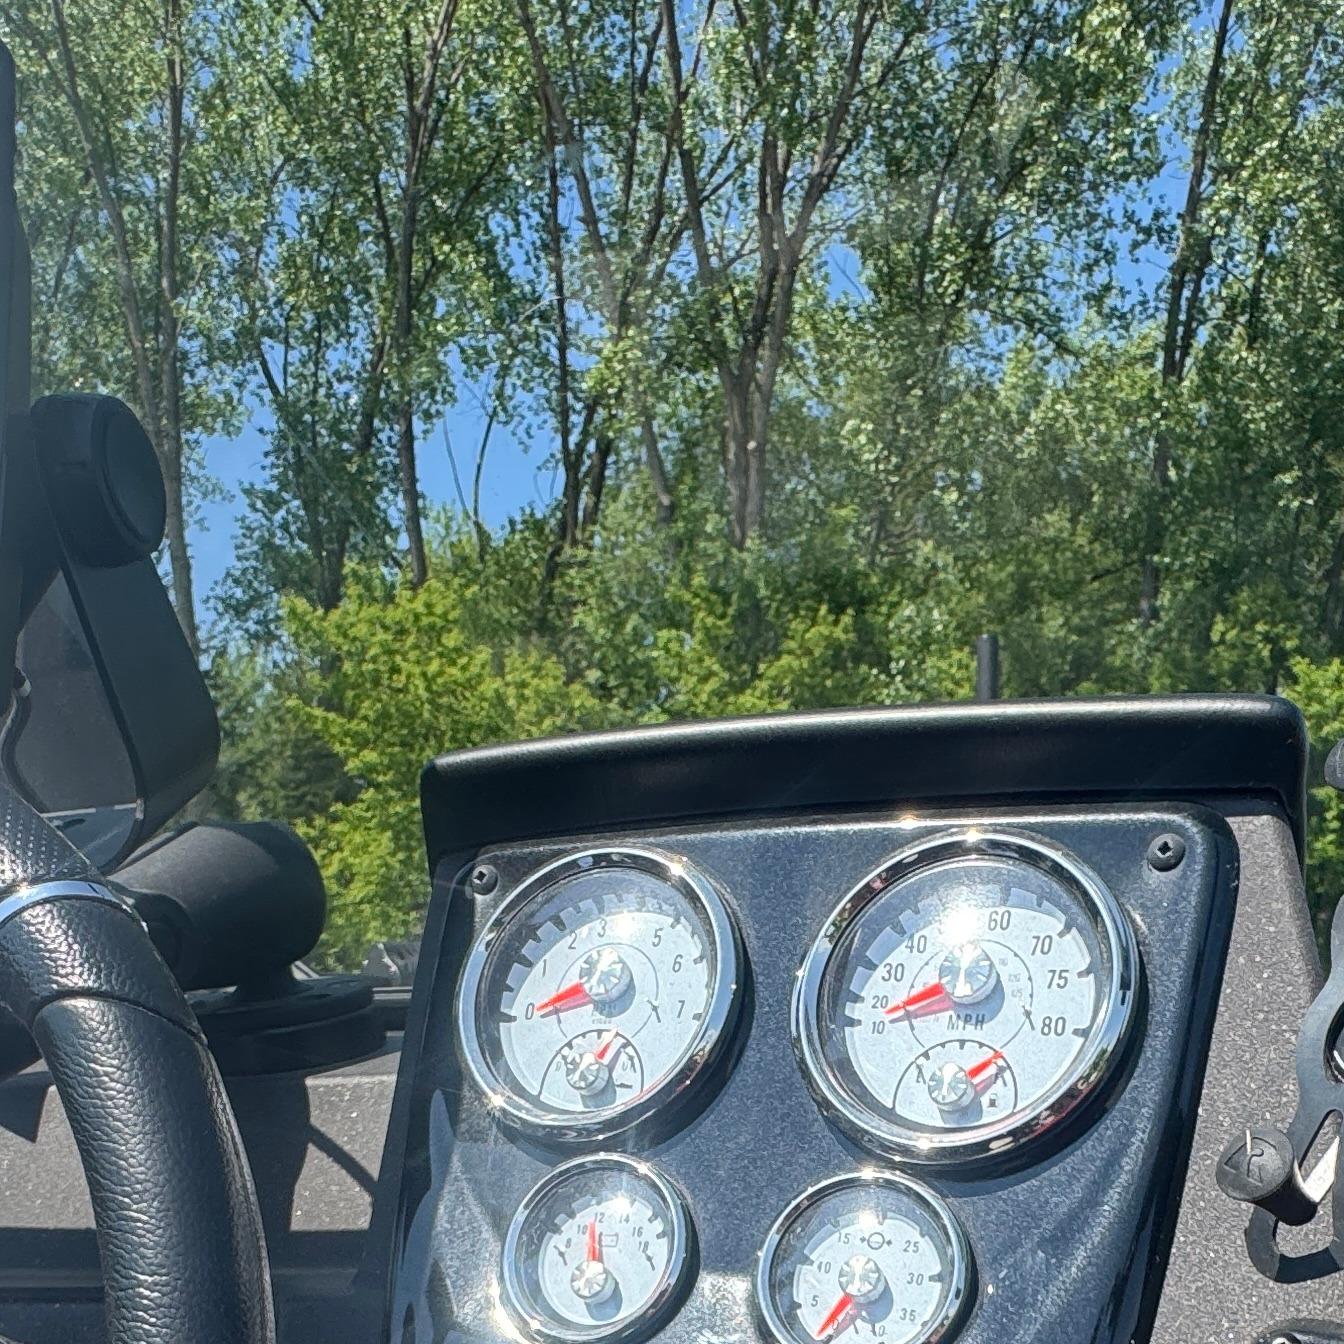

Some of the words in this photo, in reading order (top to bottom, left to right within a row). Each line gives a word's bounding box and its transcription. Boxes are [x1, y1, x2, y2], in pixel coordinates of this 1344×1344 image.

[597, 918, 606, 938] 3
[987, 910, 1012, 931] 60
[567, 932, 578, 950] 2
[652, 928, 663, 947] 5
[905, 934, 928, 954] 40
[1030, 935, 1053, 956] 70
[541, 959, 547, 977] 1
[672, 954, 683, 973] 6
[881, 962, 905, 982] 30
[1047, 969, 1069, 989] 75
[676, 1000, 686, 1019] 7
[871, 995, 888, 1009] 20
[524, 1002, 535, 1021] 0
[871, 1020, 886, 1035] 10
[946, 1013, 986, 1032] MPH
[1040, 1016, 1066, 1037] 80
[594, 1212, 606, 1224] 12
[577, 1224, 589, 1236] 10
[631, 1226, 644, 1238] 16
[837, 1231, 851, 1245] 15
[903, 1239, 920, 1254] 25
[906, 1272, 924, 1286] 30
[810, 1294, 820, 1308] 5
[899, 1307, 917, 1322] 35
